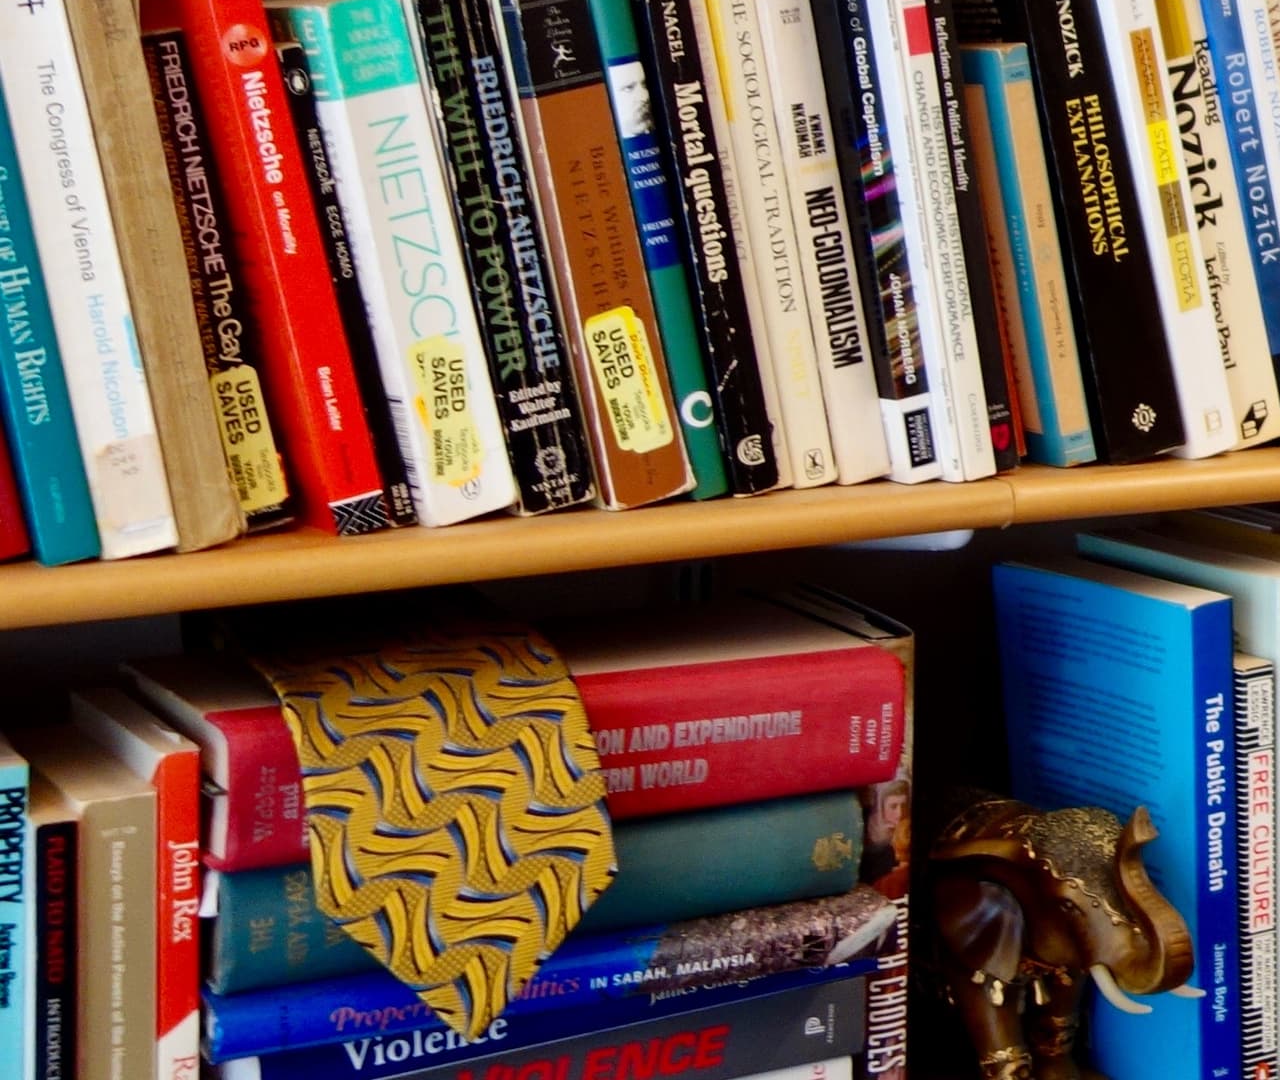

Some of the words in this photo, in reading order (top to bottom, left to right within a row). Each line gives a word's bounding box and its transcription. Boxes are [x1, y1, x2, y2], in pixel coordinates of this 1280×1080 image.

[428, 5, 465, 81] THE
[662, 0, 686, 63] NAGEL
[37, 59, 56, 96] The
[159, 41, 200, 151] FRIEDRICH
[1193, 38, 1221, 128] Reading
[1225, 52, 1258, 153] Robert
[46, 103, 75, 189] Congress
[243, 70, 283, 185] Nietzsche
[442, 84, 487, 183] WILL
[674, 80, 715, 166] Mortal
[1152, 128, 1172, 178] STATE
[1168, 56, 1224, 231] Nozick
[64, 187, 85, 213] of
[272, 191, 282, 205] on
[461, 184, 499, 237] TO
[1066, 98, 1109, 256] EXPLANATIONS
[1084, 94, 1129, 262] PHILOSOPHICAL
[70, 210, 96, 282] Vienna
[186, 155, 227, 275] NIETZSCHE
[275, 207, 298, 255] Morality
[367, 113, 460, 338] NIETZSC
[472, 55, 528, 208] FRIEDRICH
[509, 212, 562, 373] NIETZSCHE
[684, 168, 728, 283] questions
[209, 275, 233, 316] The
[477, 237, 527, 382] POWER
[805, 186, 864, 369] NEO-COLONIALISM
[219, 319, 243, 370] Gay
[592, 330, 621, 390] SAVES
[609, 327, 634, 379] USED
[217, 382, 245, 445] SAVES
[236, 380, 261, 434] USED
[432, 356, 449, 420] SAVES
[449, 359, 466, 412] USED
[1205, 693, 1224, 735] The
[1207, 731, 1226, 806] Public
[1252, 754, 1270, 814] FREE
[168, 839, 199, 892] John
[1206, 810, 1226, 892] Domain
[1252, 824, 1270, 927] CULTURE
[171, 898, 199, 945] Rex
